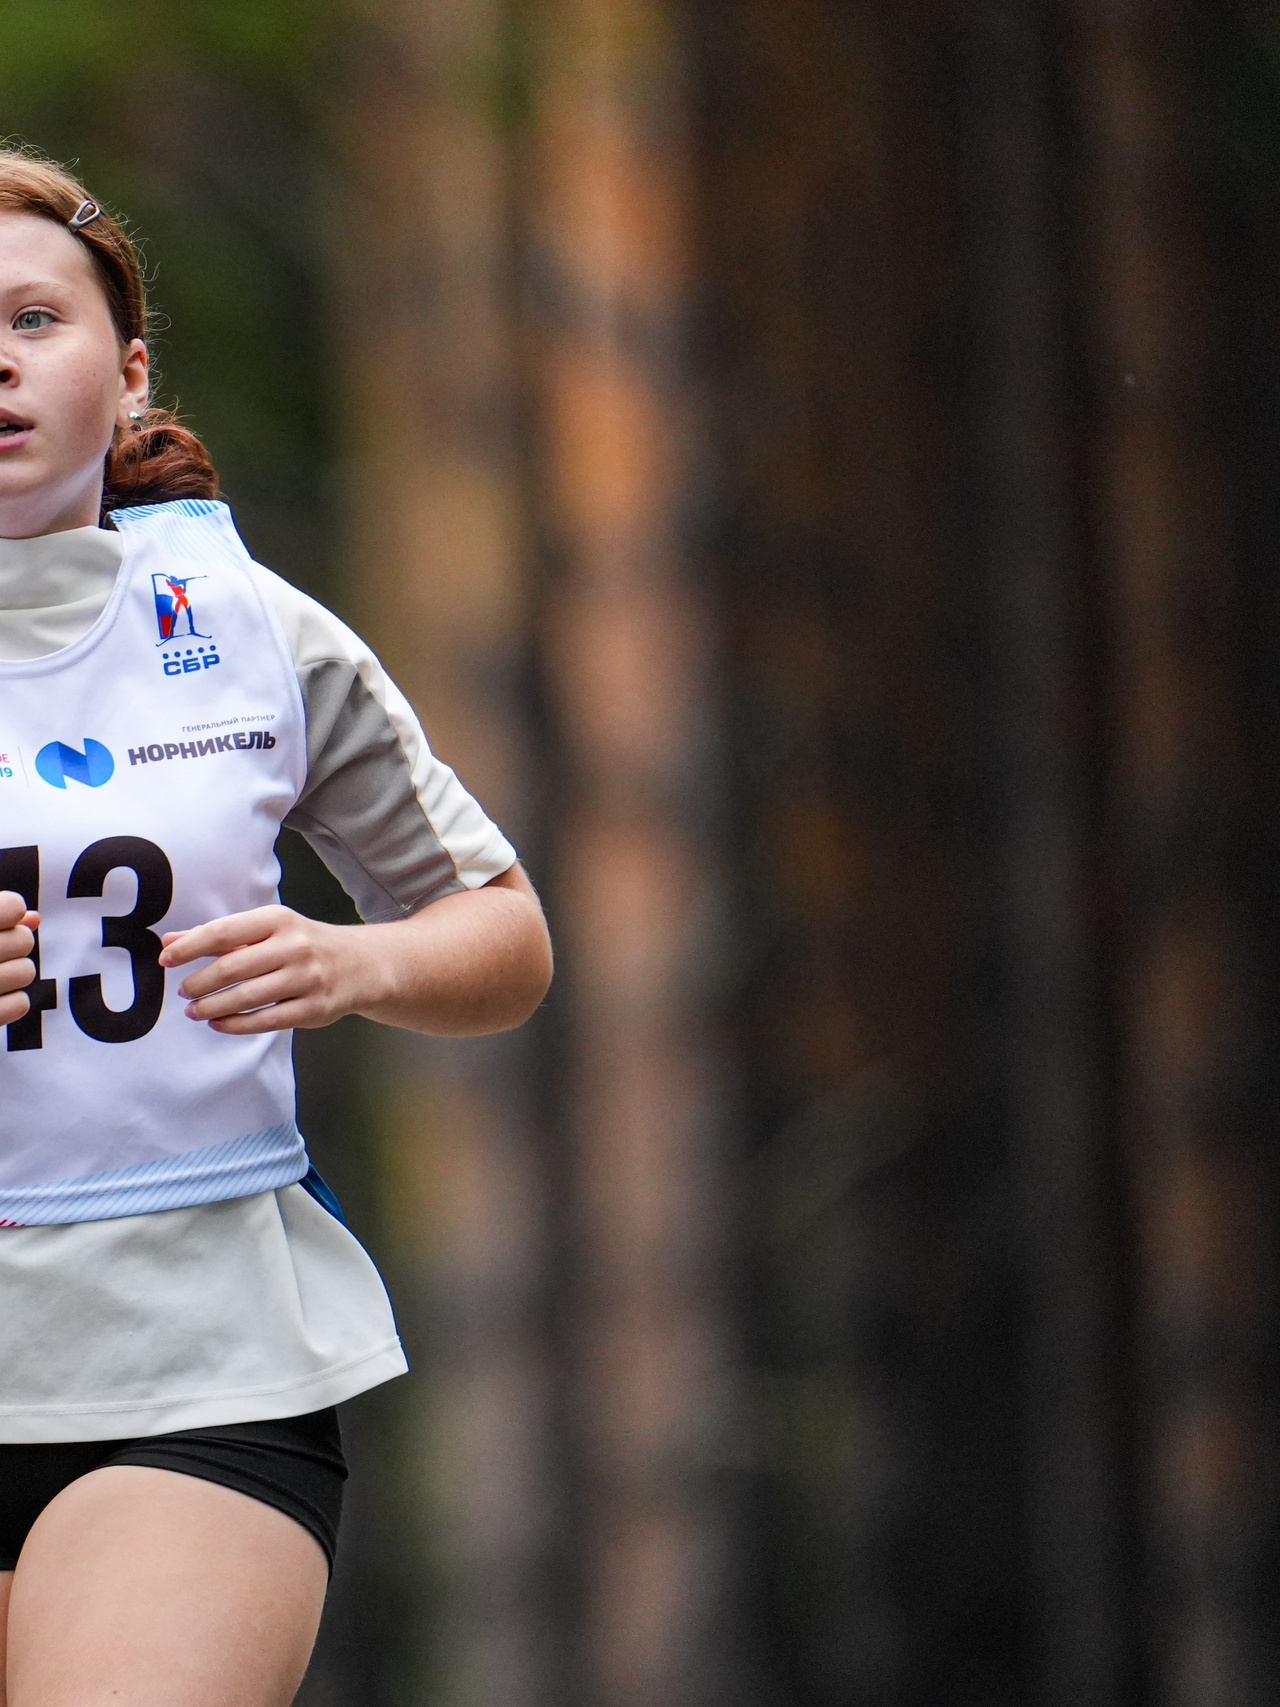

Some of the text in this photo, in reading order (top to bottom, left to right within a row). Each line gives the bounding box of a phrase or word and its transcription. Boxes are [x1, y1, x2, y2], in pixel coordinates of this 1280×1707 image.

[163, 653, 220, 676] СБР
[182, 714, 276, 733] ГЕНЕРАЛЬНЫЙ ПАРТНЕР
[127, 731, 277, 766] НОРНИКЕЛЬ
